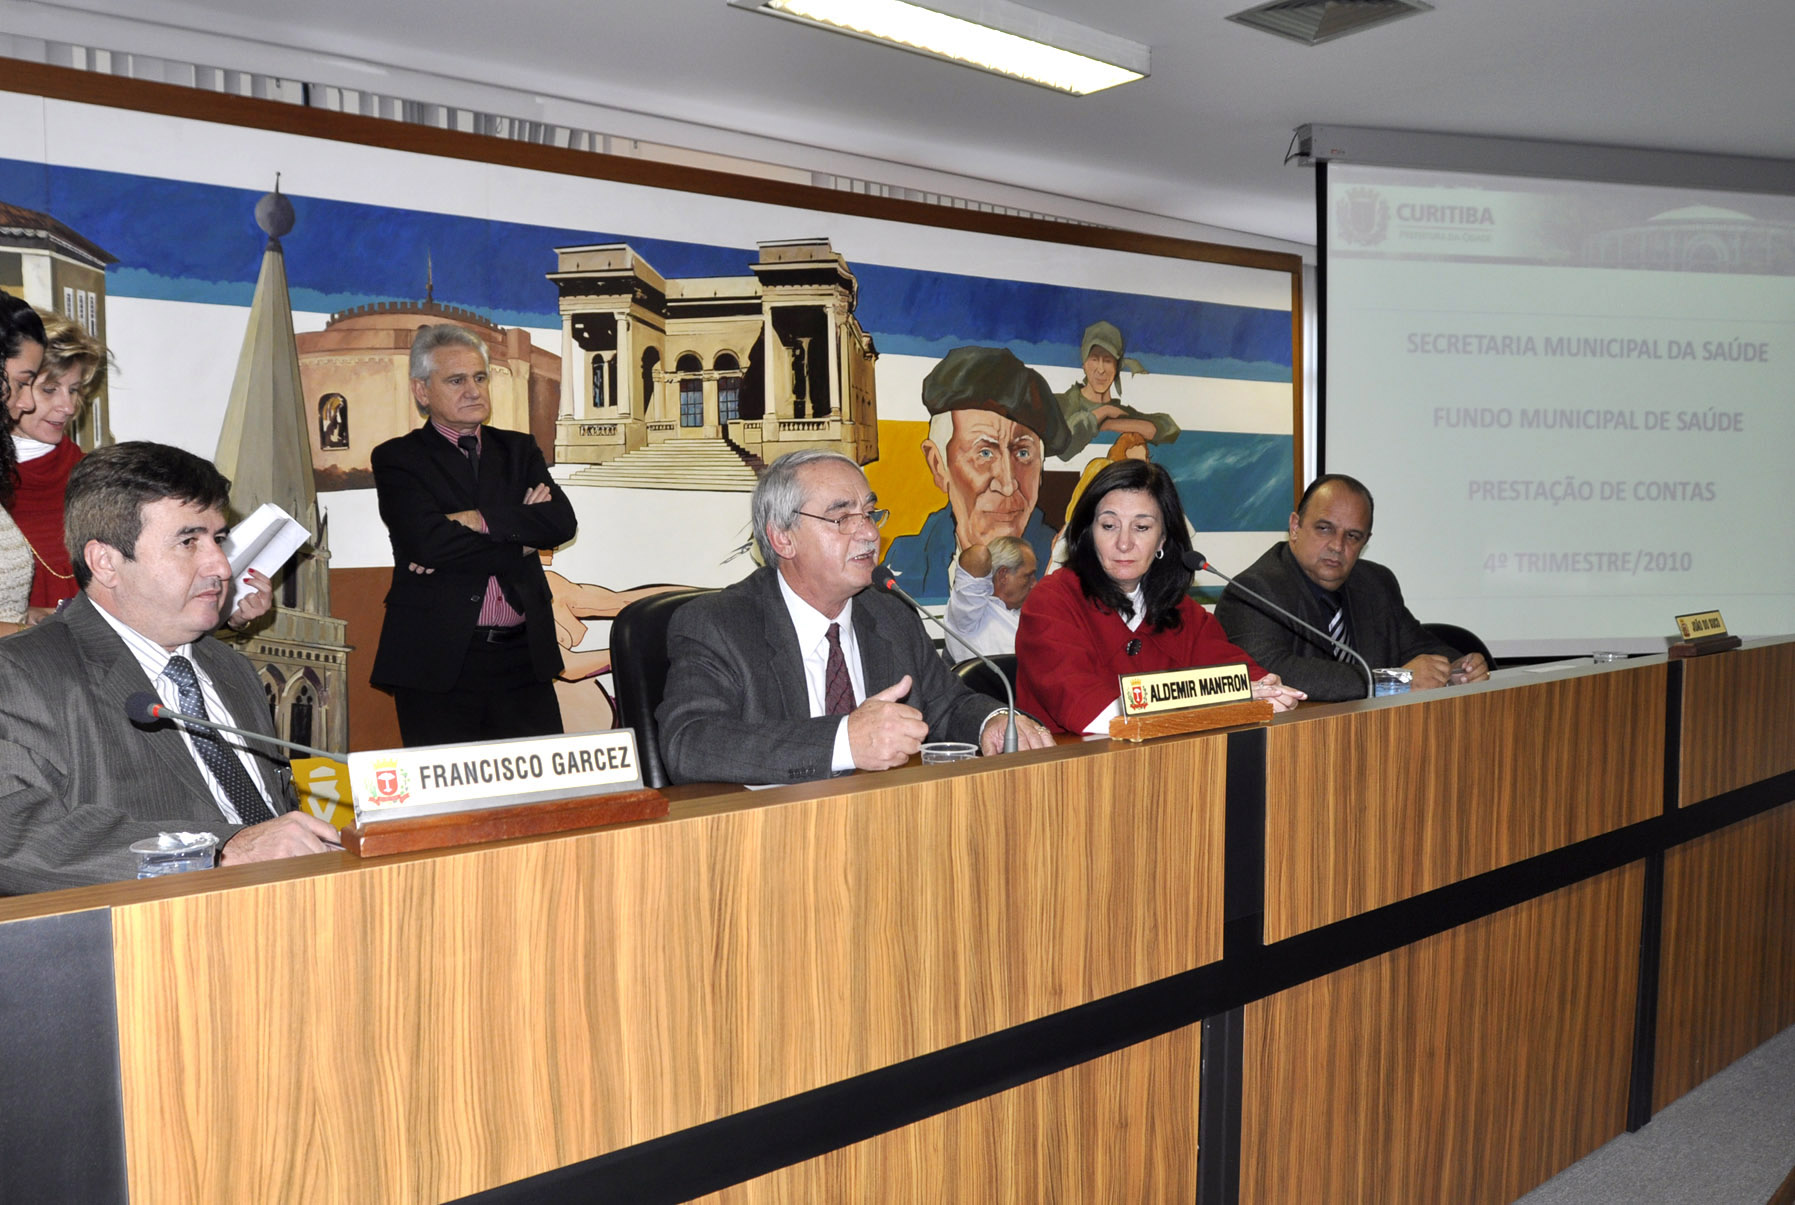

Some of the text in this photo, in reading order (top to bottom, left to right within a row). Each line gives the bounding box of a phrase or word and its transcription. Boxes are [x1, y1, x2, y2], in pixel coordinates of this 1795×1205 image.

[1395, 203, 1495, 225] CURITIBA
[1407, 333, 1769, 362] SECRETARIA MUNICIPAL DA SAÚDE
[1433, 406, 1743, 432] FUNDO MUNICIPAL DE SAÚDE
[1468, 476, 1716, 506] PRESTAÇÃO DE CONTAS
[1515, 550, 1692, 576] TRIMESTRE/2010
[1150, 673, 1249, 702] ALDEMIR MANFRON
[419, 746, 631, 789] FRANCISCO GARCEZ
